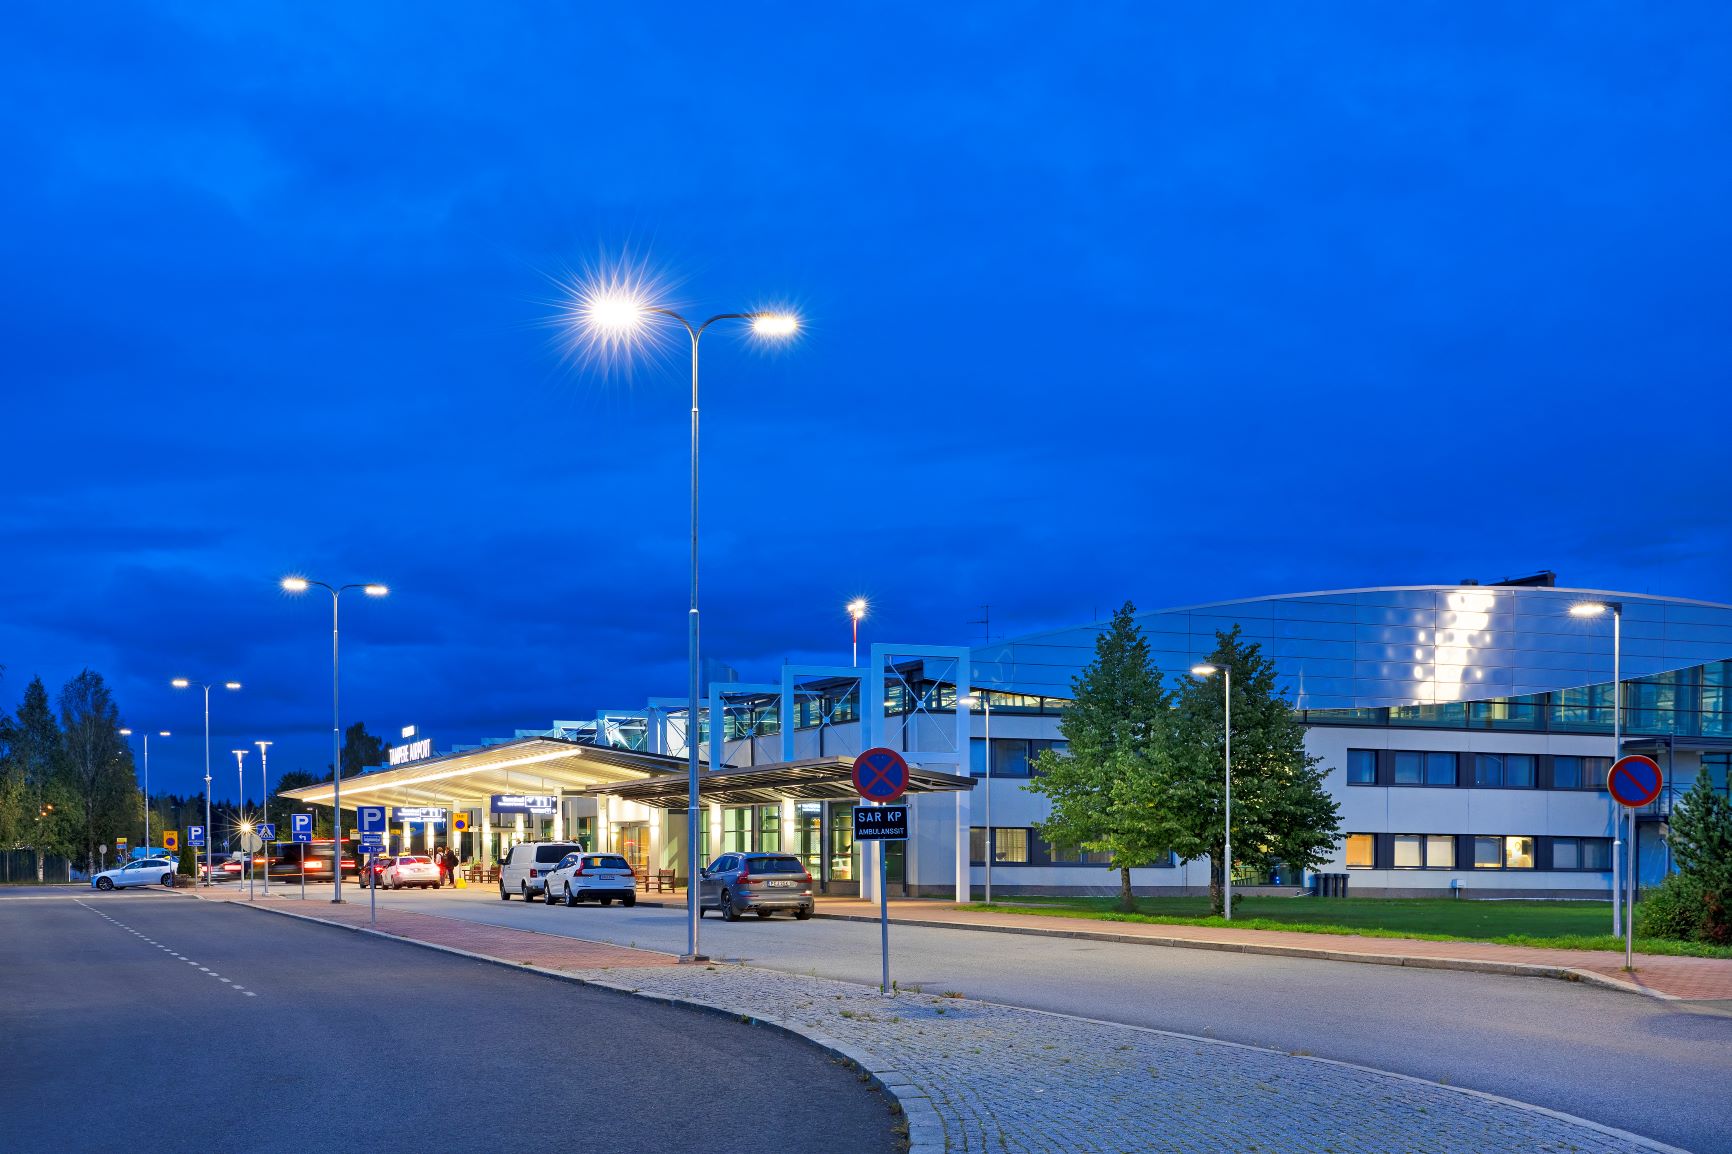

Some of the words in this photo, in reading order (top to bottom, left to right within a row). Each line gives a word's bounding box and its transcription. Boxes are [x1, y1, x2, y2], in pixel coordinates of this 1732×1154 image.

[389, 744, 409, 765] TAMPERE
[409, 738, 431, 761] AIRPORT
[295, 815, 309, 831] P
[363, 808, 381, 831] P
[858, 812, 882, 822] SAR
[887, 811, 902, 822] KP
[191, 827, 202, 840] P
[858, 827, 904, 836] AMBULANSSIT
